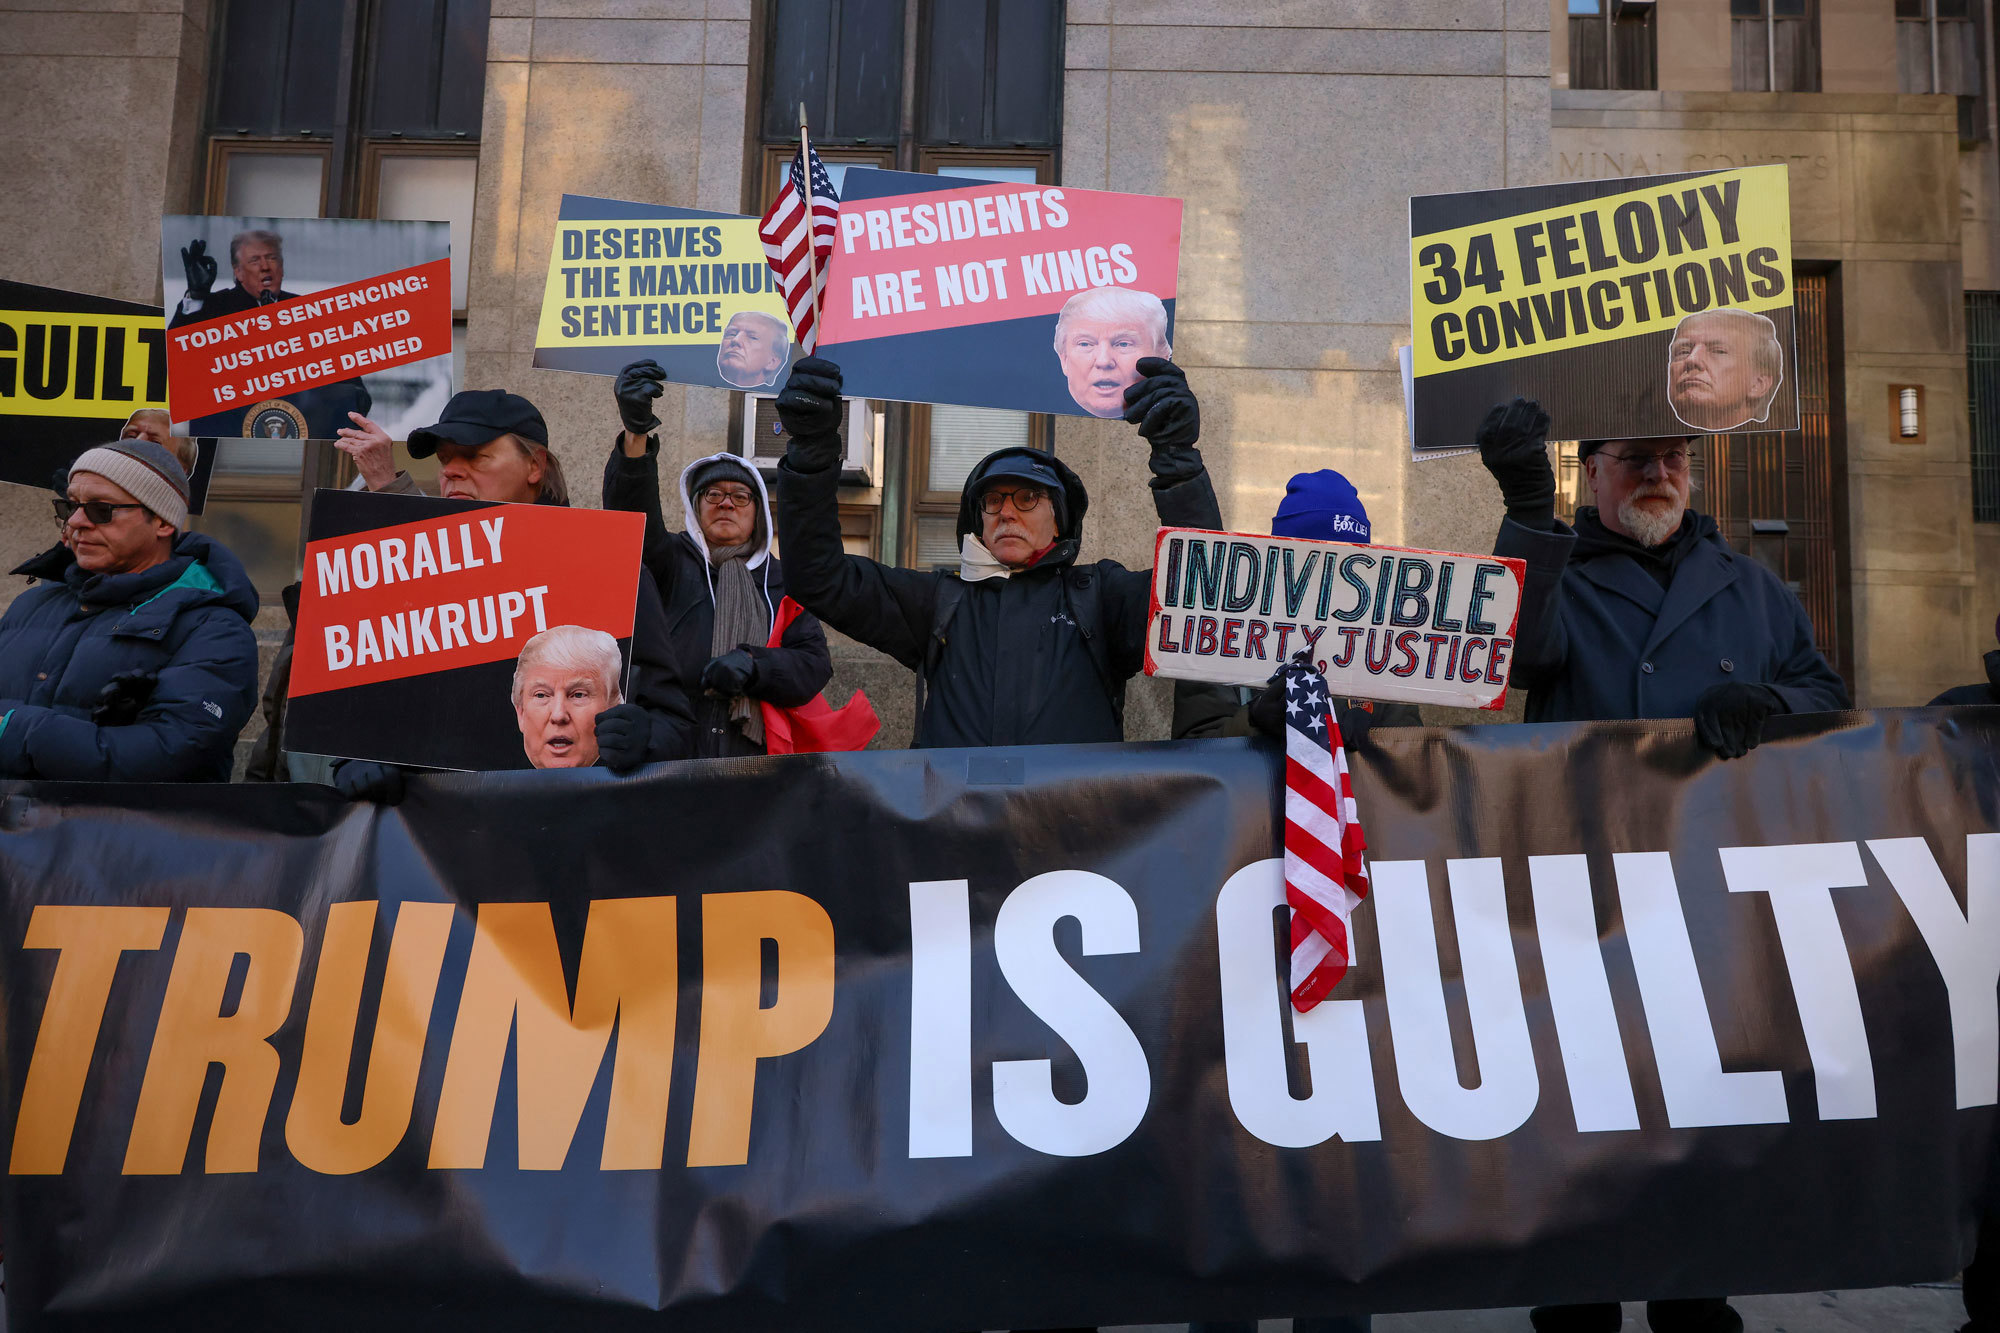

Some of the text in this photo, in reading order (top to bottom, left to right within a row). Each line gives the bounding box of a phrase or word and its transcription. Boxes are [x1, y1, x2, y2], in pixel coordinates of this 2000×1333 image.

[562, 226, 722, 260] DESERVES
[840, 189, 1069, 254] PRESIDENTS
[1418, 179, 1741, 305] 34 FELONY
[175, 275, 429, 352] TODAY'S SENTENCING:
[561, 266, 620, 298] THE
[851, 243, 1138, 319] ARE NOT KINGS
[1430, 247, 1785, 362] CONVICTIONS
[210, 308, 411, 374] JUSTICE DELAYED
[561, 302, 722, 338] SENTENCE
[213, 336, 423, 403] IS JUSTICE DENIED
[315, 517, 504, 597] MORALLY
[1334, 520, 1368, 536] FOX LIES
[1165, 538, 1505, 636] INDIVISIBLE
[324, 585, 548, 671] BANKRUPT
[1333, 626, 1513, 686] JUSTICE
[9, 833, 2000, 1175] TRUMP IS GUILTY
